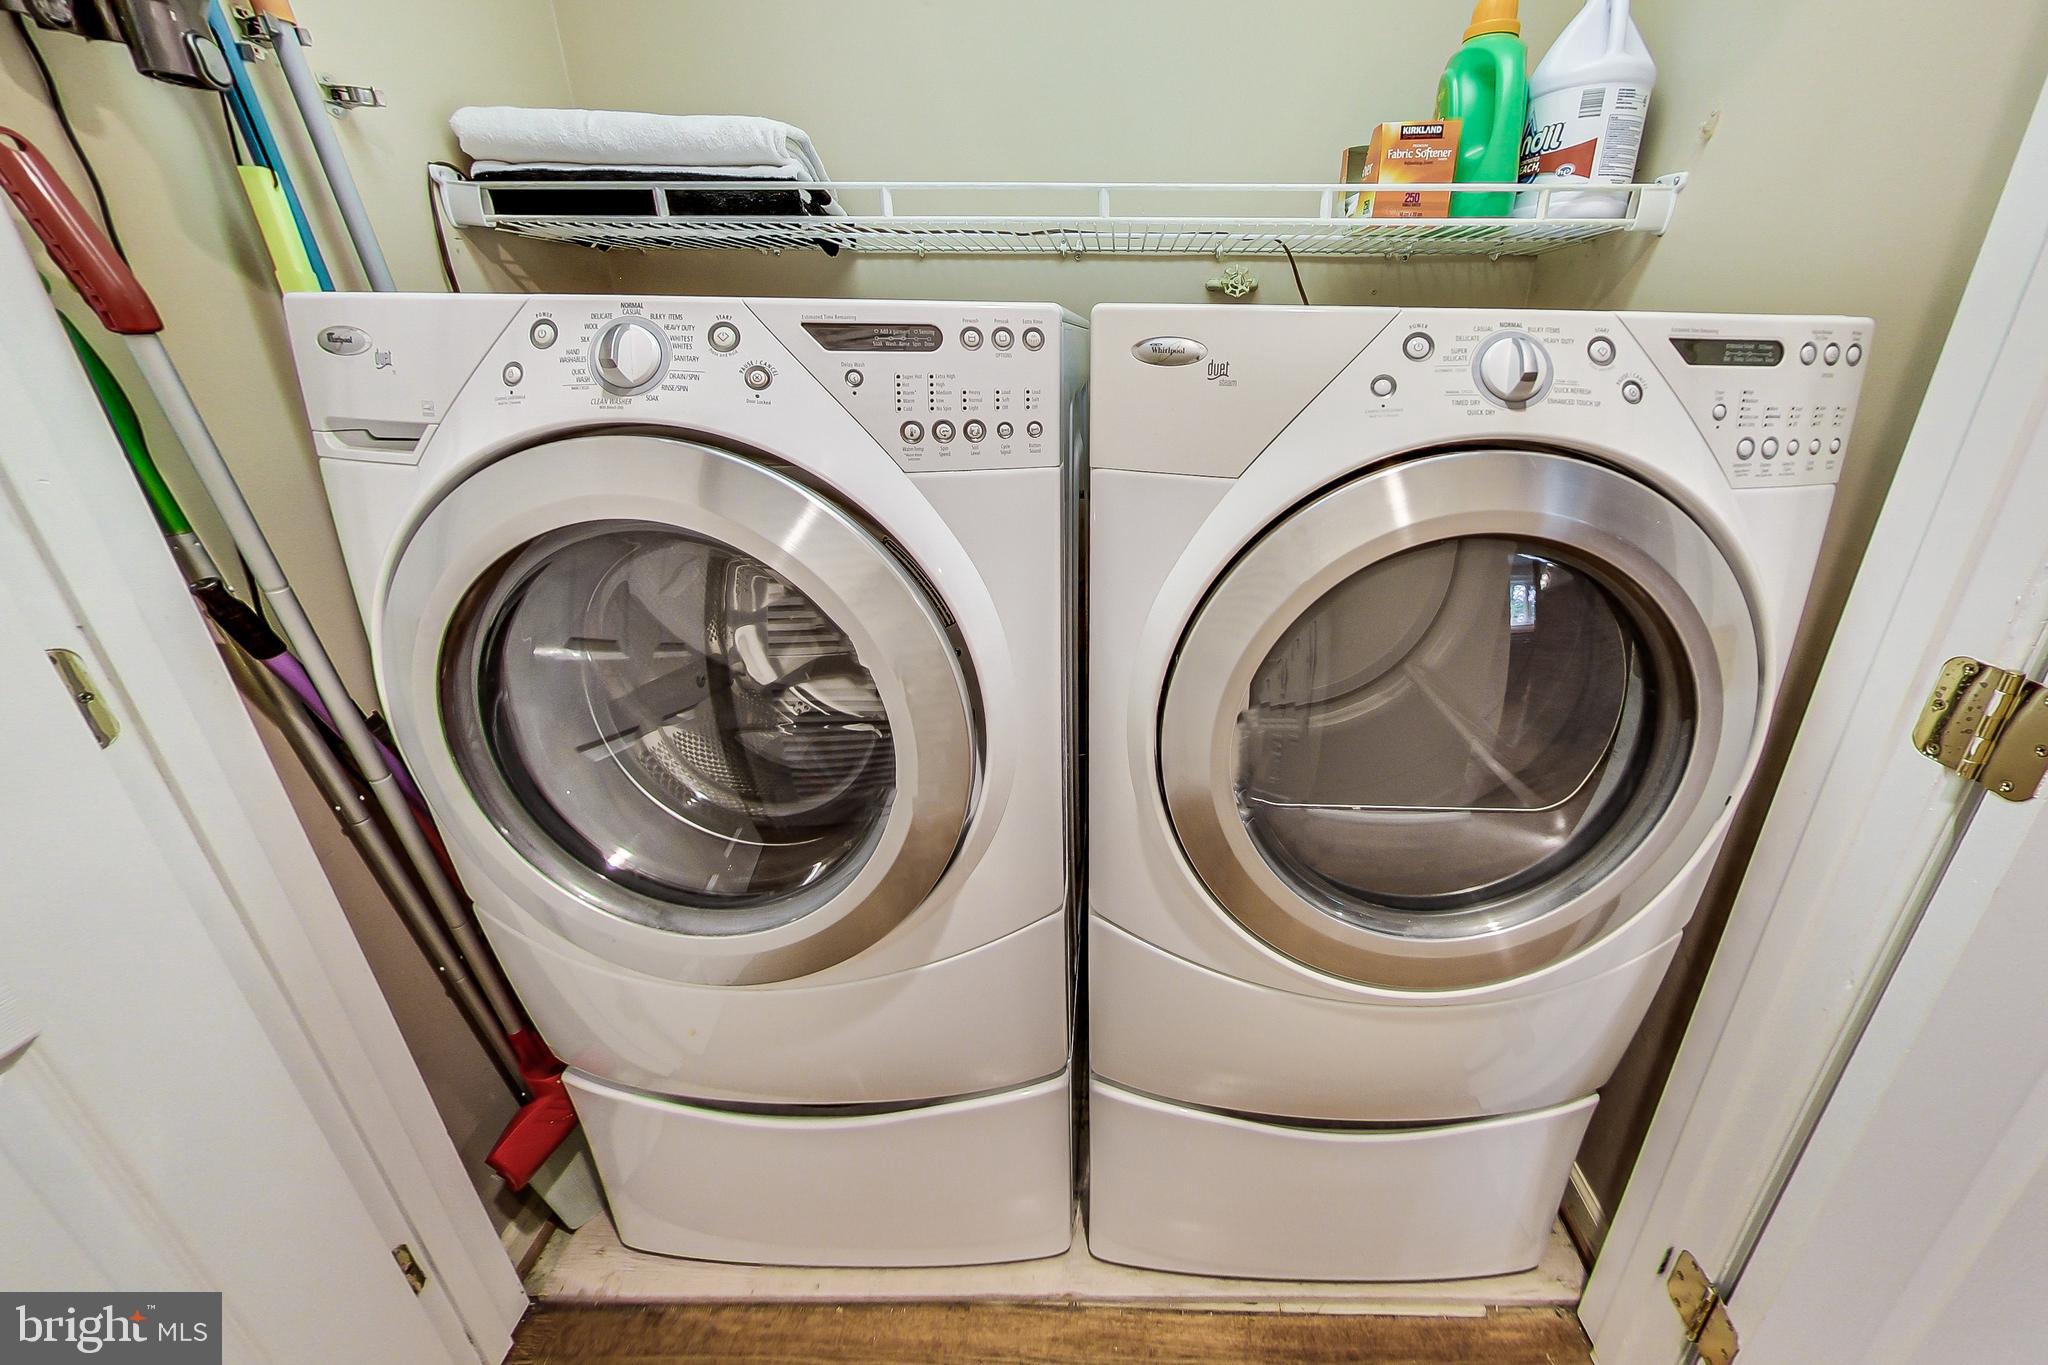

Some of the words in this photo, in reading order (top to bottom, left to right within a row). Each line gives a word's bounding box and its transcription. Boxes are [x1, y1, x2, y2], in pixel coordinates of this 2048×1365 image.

[1402, 125, 1443, 135] KIRKLAND
[1387, 149, 1414, 159] Fabric
[1415, 147, 1452, 160] Softener
[1404, 192, 1420, 203] 250
[590, 312, 613, 320] DELICATE
[668, 313, 684, 321] ITEMS
[681, 324, 696, 332] DUTY
[669, 335, 694, 343] WHITEST
[1151, 346, 1186, 356] Whirlpool
[673, 354, 700, 363] SANITARY
[1207, 359, 1230, 377] duet
[668, 373, 700, 381] DRAIN/SPIN
[660, 384, 689, 392] RINSE/SPIN
[645, 394, 660, 402] SOAK
